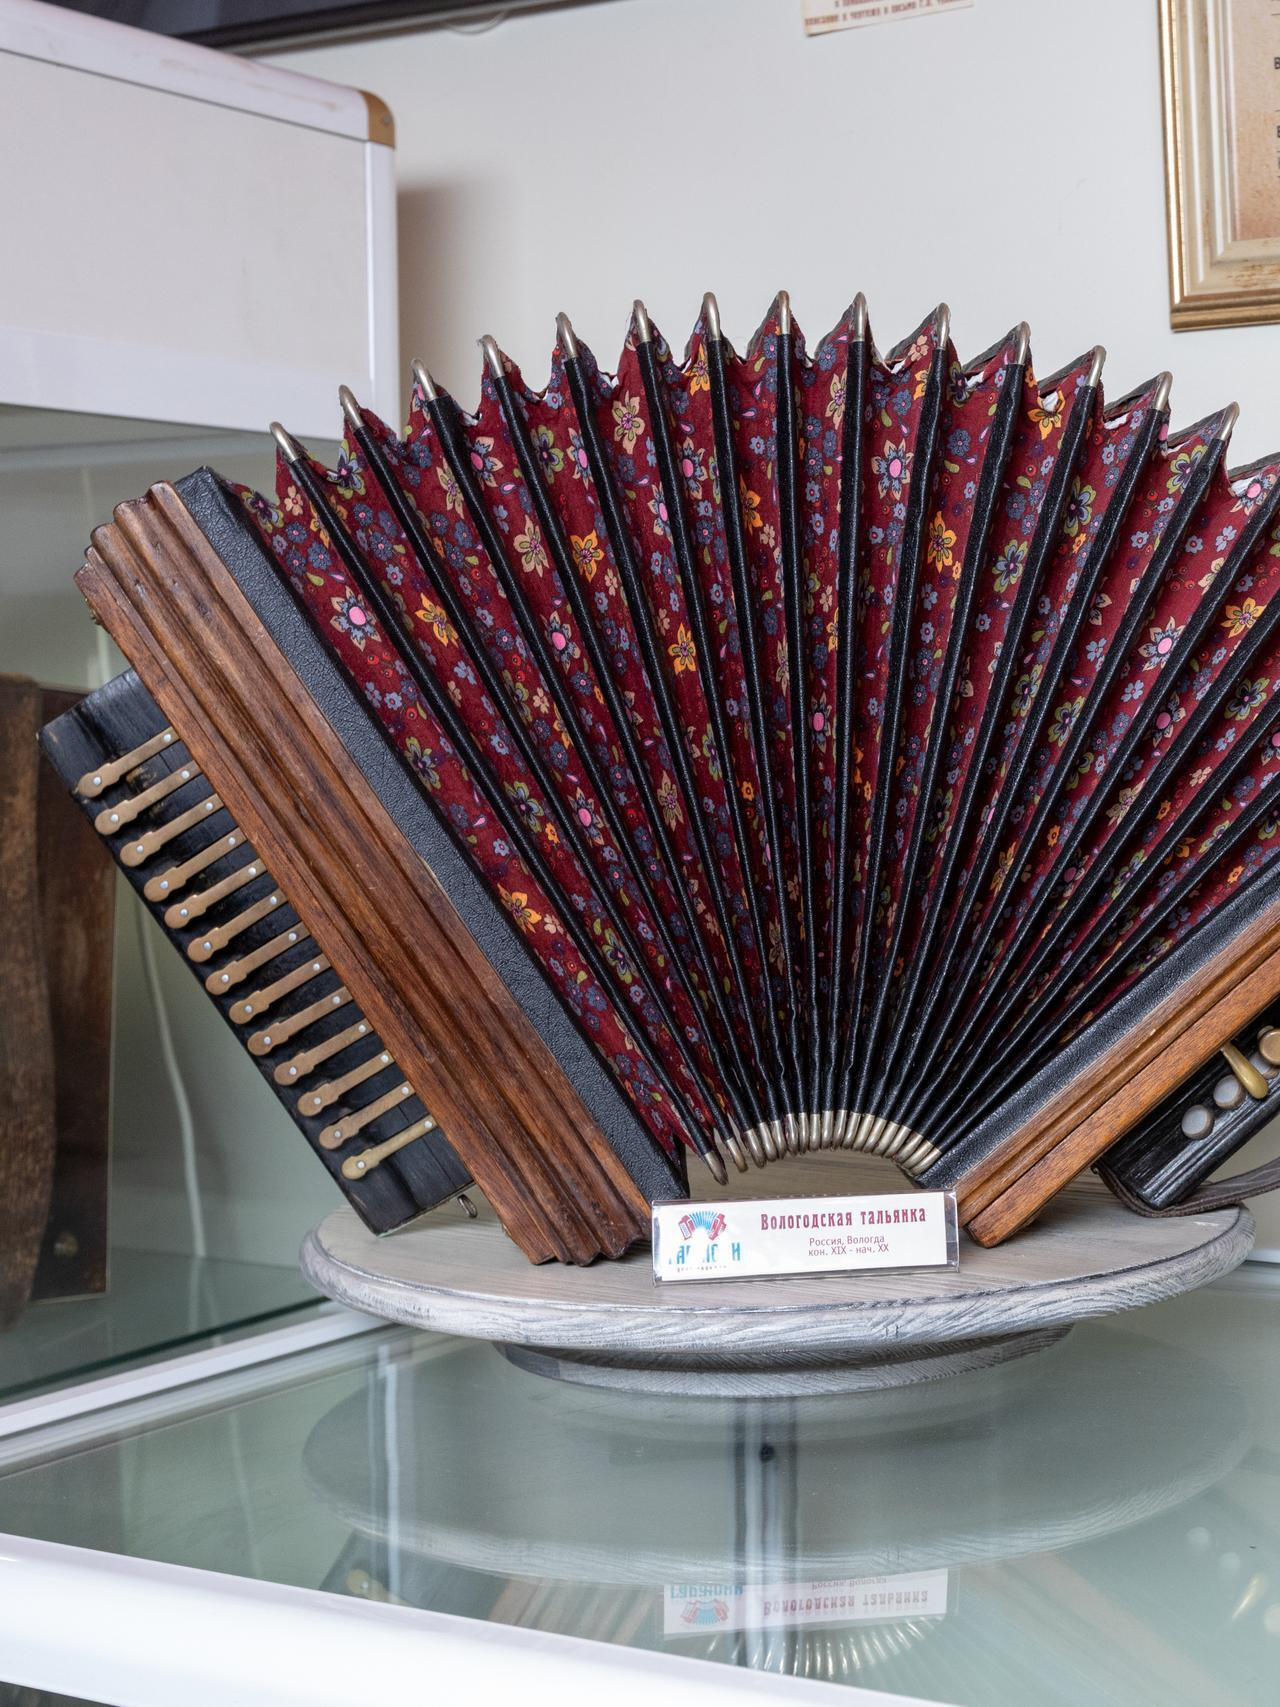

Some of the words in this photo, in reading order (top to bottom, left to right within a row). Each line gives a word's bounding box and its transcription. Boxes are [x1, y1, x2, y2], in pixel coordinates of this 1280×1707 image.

[760, 1209, 852, 1231] Вологодская
[861, 1207, 927, 1226] тальянка
[809, 1237, 845, 1247] Россия,
[847, 1234, 885, 1245] Вологда
[808, 1248, 828, 1257] кон.
[855, 1245, 876, 1255] нач.
